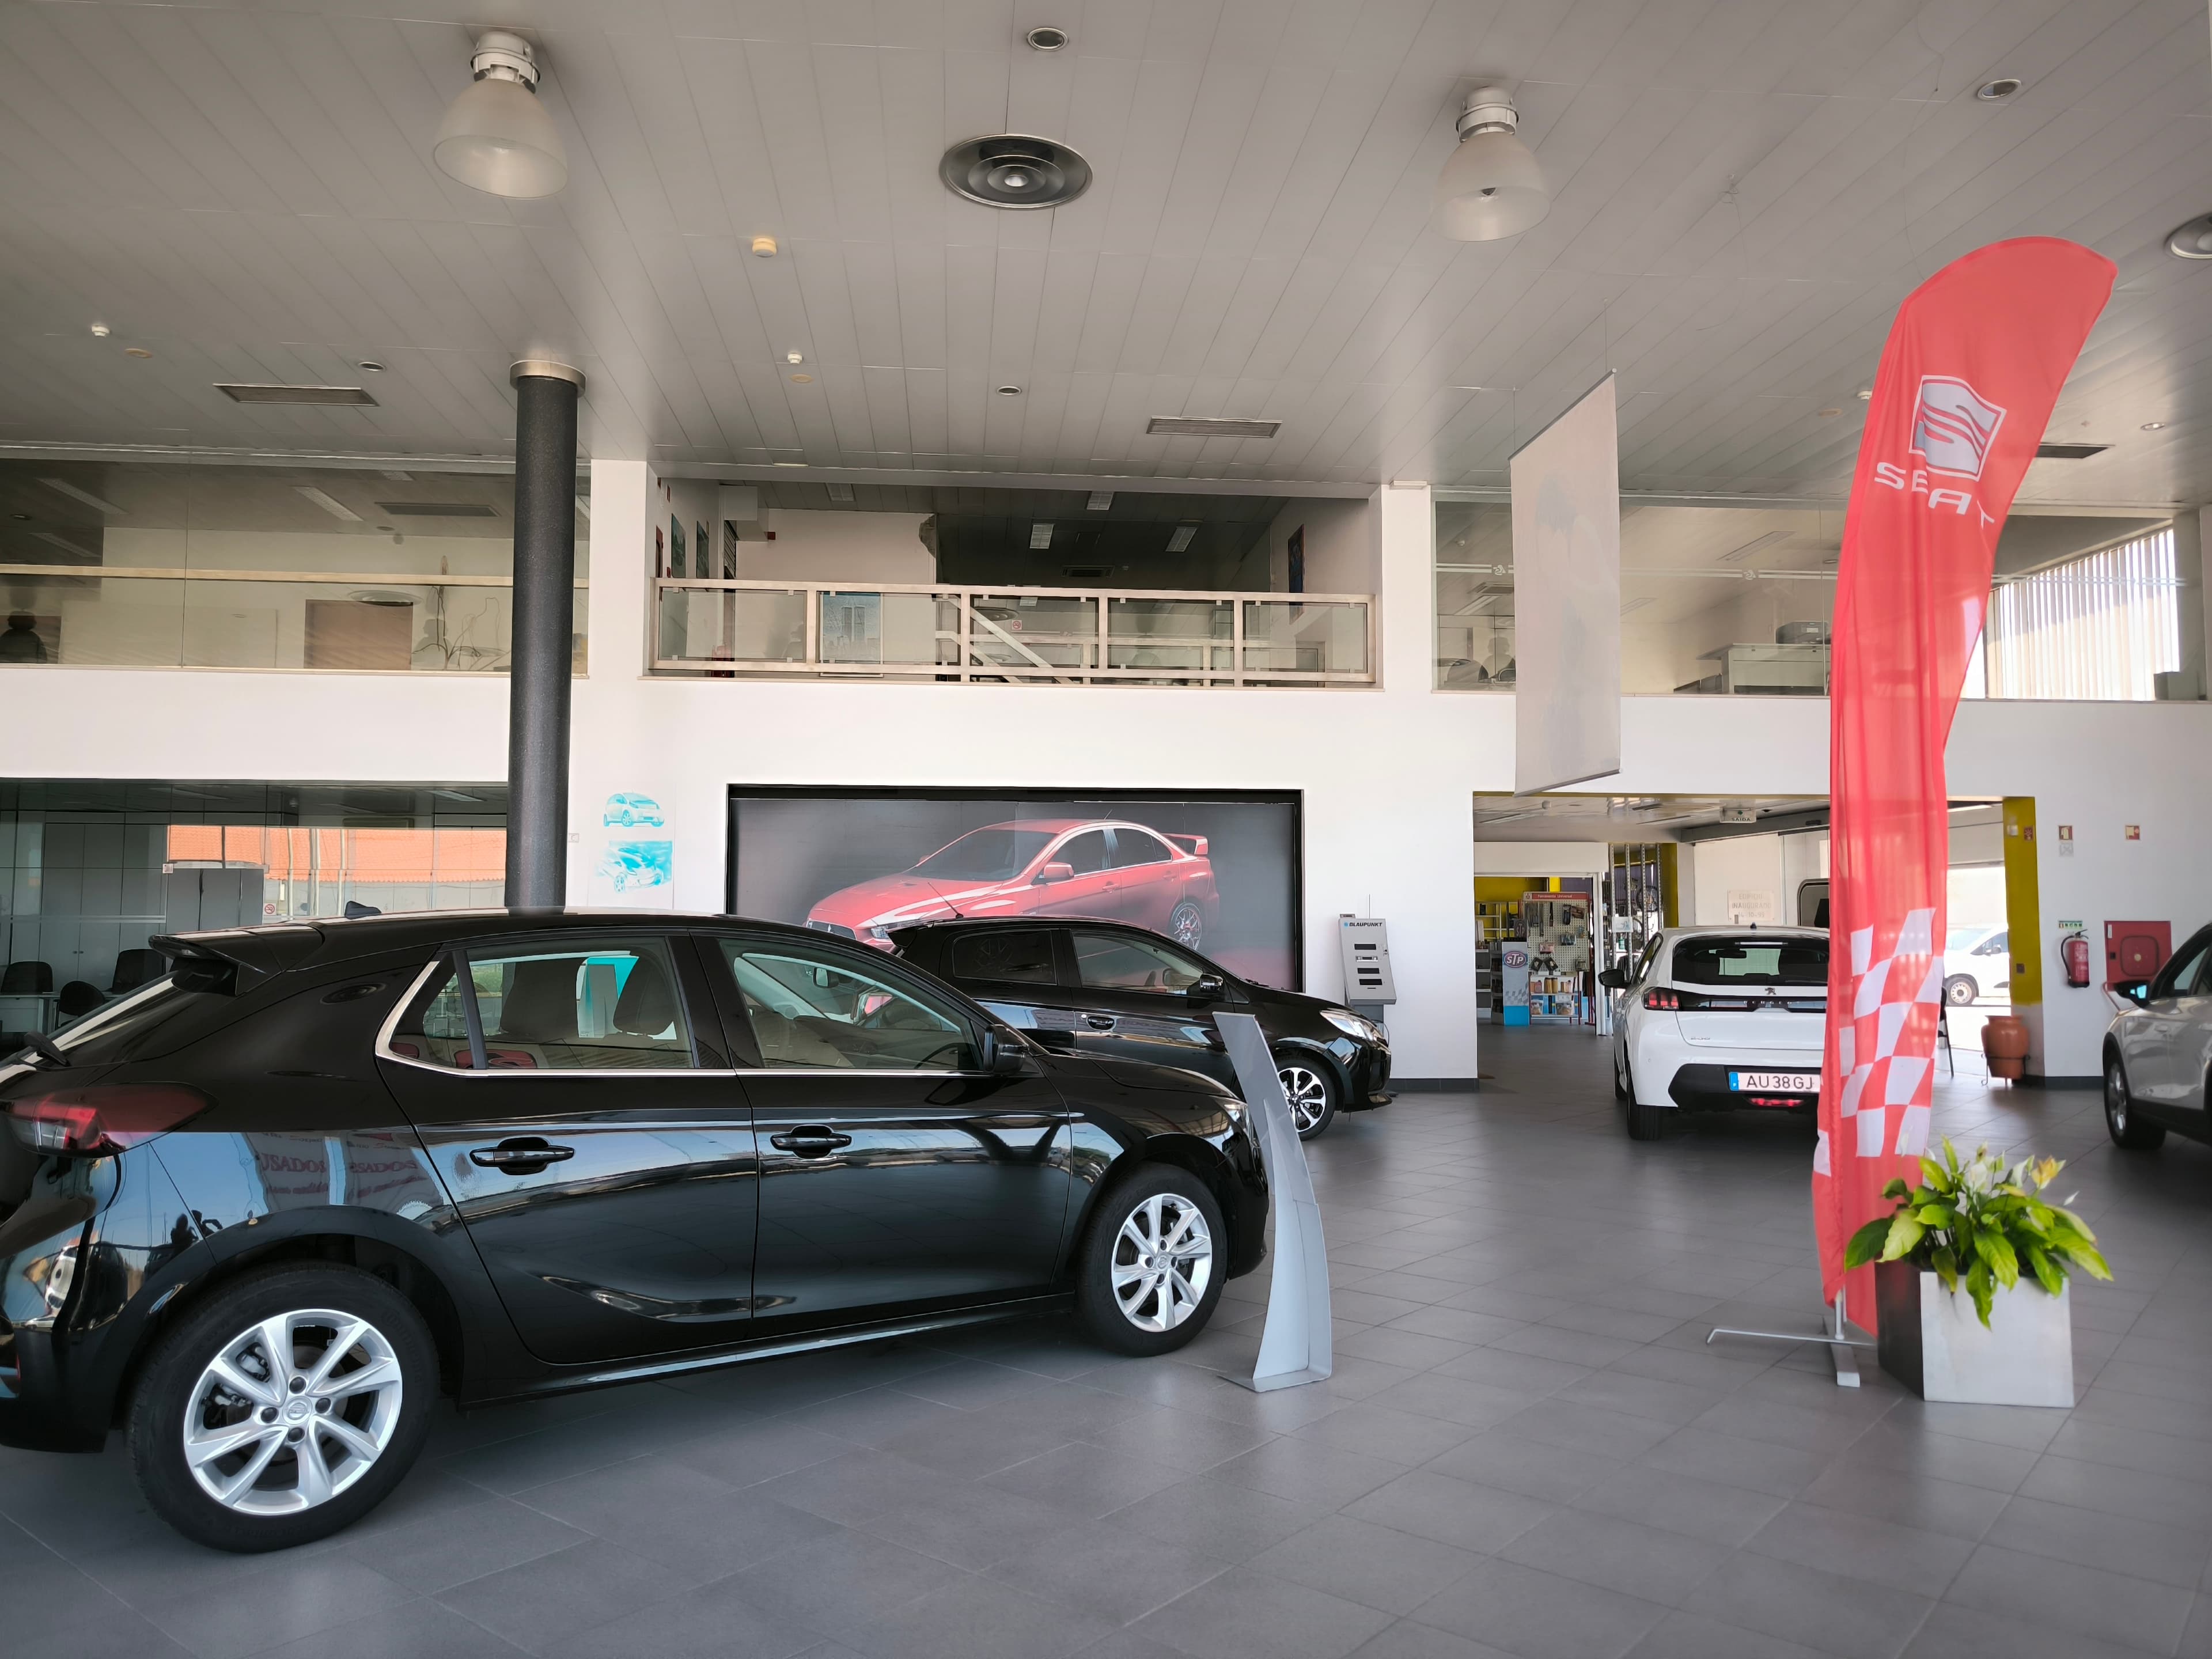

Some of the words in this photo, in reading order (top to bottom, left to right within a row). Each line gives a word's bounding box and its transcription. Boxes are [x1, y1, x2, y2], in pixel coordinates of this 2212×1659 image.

[1874, 461, 1995, 529] SEAT
[1506, 953, 1524, 965] STP
[1746, 1075, 1770, 1088] AU
[1772, 1075, 1790, 1089] 38
[1793, 1077, 1813, 1090] GJ
